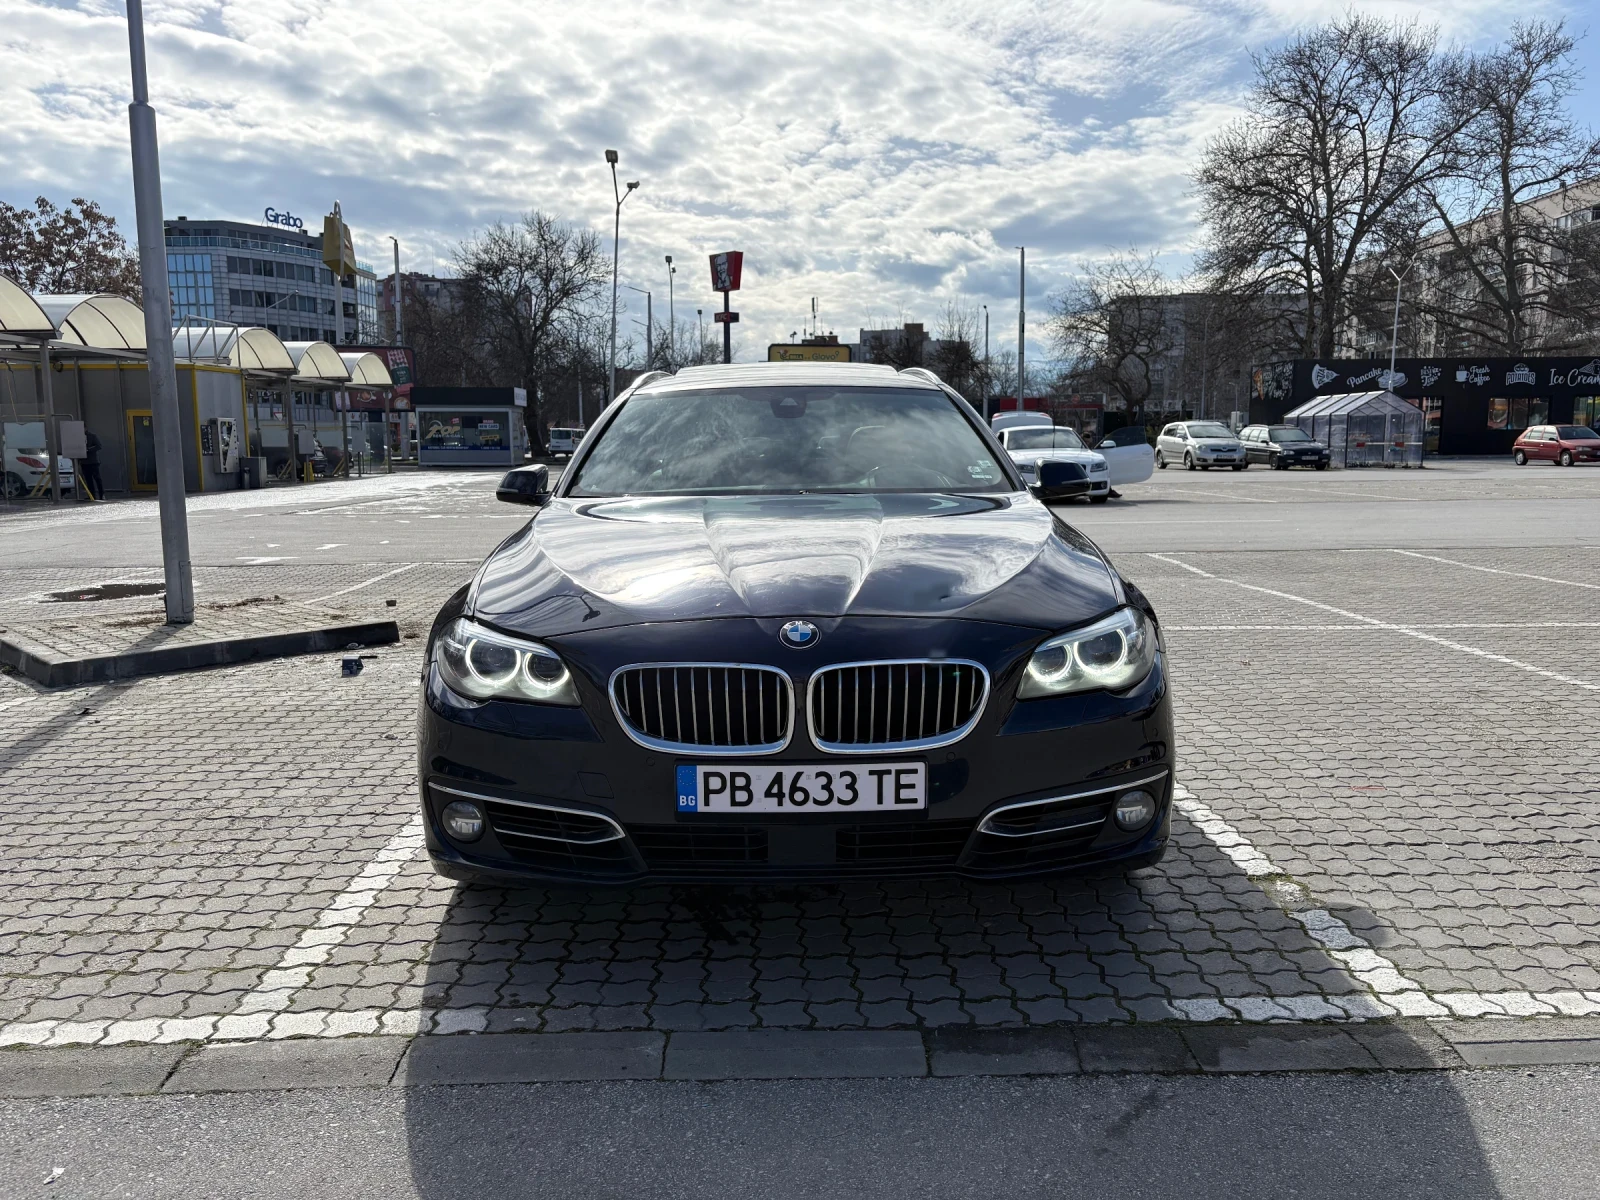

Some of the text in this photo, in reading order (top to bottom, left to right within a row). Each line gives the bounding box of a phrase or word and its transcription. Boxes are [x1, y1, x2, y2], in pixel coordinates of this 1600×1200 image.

[265, 207, 303, 229] Grabo
[716, 313, 728, 321] KFC
[812, 352, 836, 360] Glovo
[1470, 365, 1490, 376] Fresh
[1549, 368, 1565, 386] Ice
[1347, 368, 1383, 388] Pancake
[1469, 374, 1490, 386] Coffee
[1506, 371, 1536, 386] POTATOES
[425, 425, 460, 439] TOP
[702, 768, 919, 807] PB 4633 TE
[679, 795, 696, 806] BG
